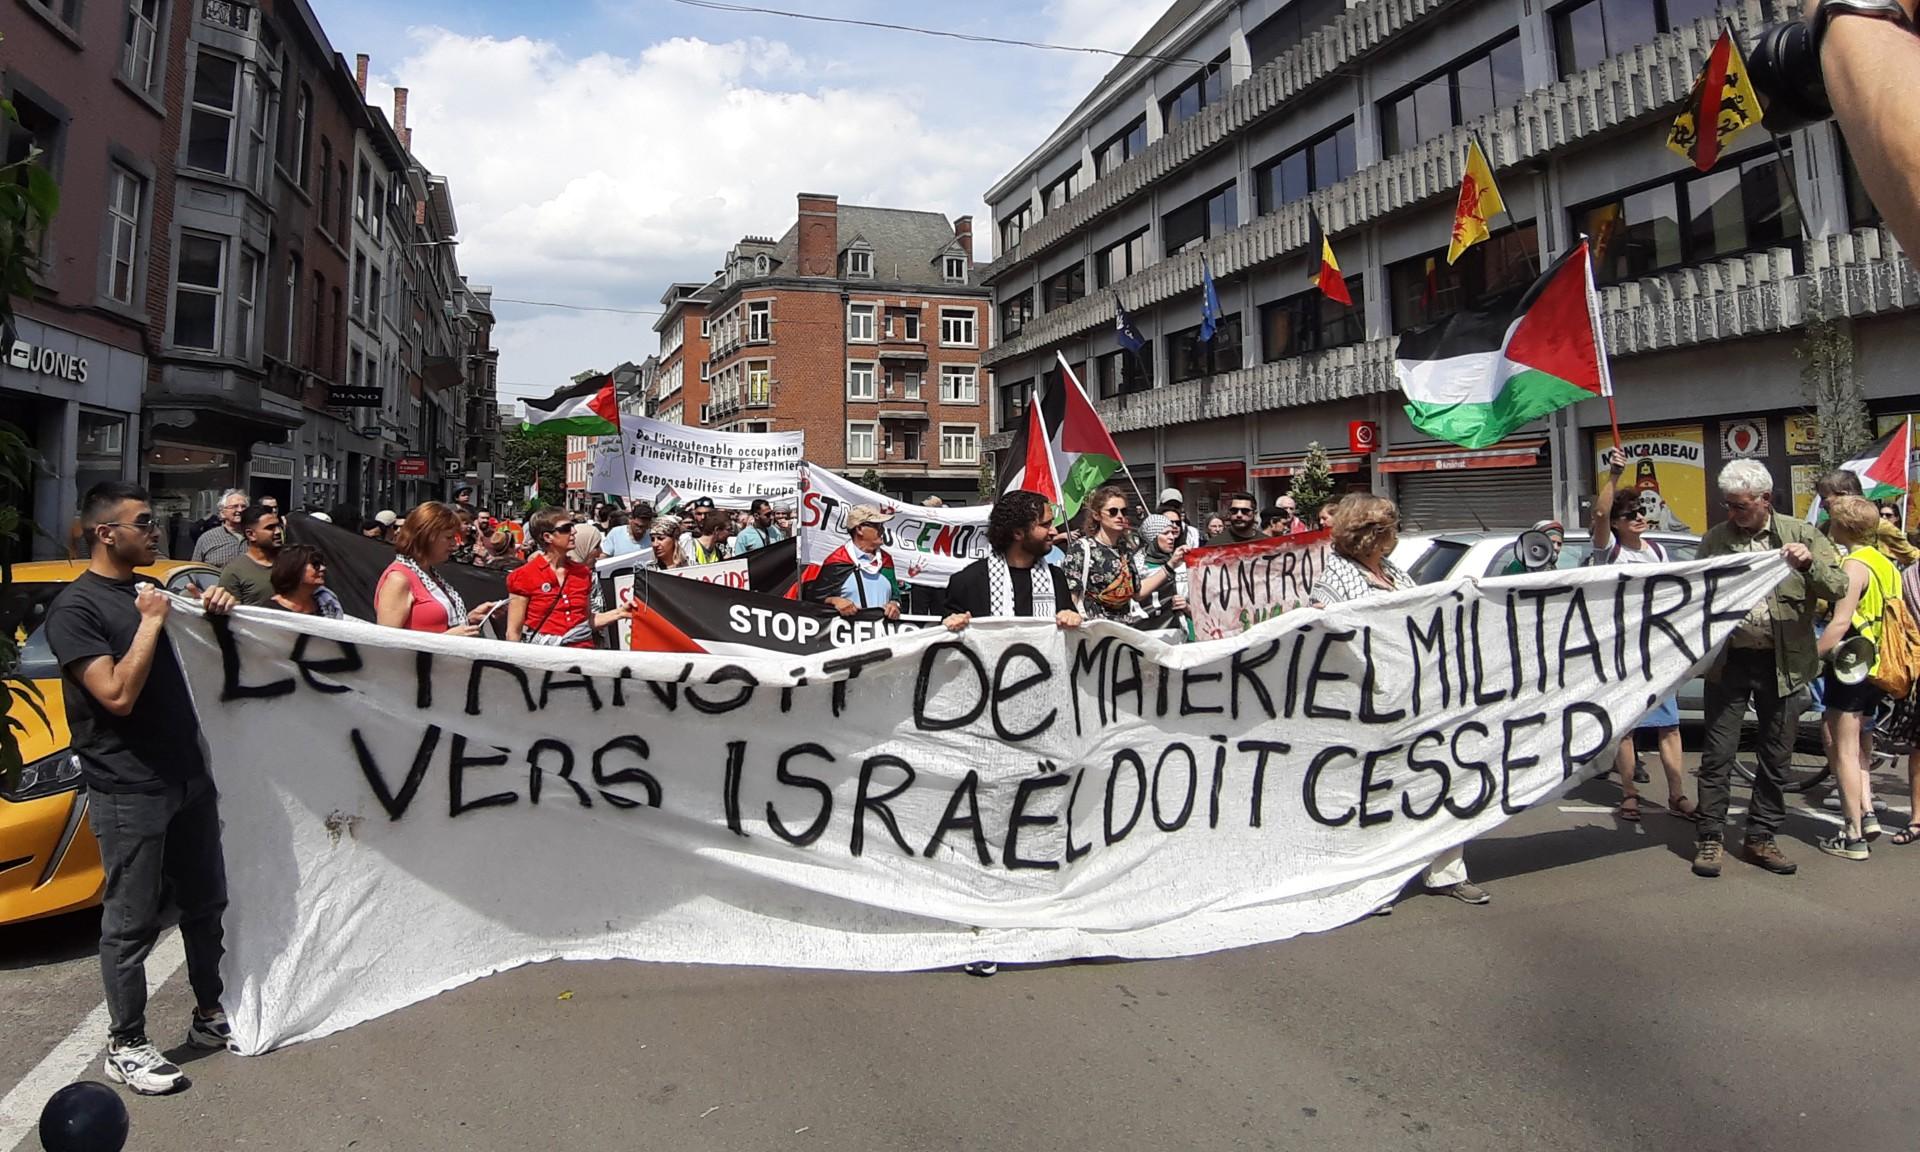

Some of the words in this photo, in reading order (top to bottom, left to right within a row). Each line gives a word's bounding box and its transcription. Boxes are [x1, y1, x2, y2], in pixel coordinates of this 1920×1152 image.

[30, 347, 89, 383] JONES
[332, 392, 379, 400] MANO
[630, 443, 636, 456] à
[640, 444, 705, 466] l'inévitable
[636, 428, 650, 441] De
[654, 432, 733, 456] l'insoutenable
[738, 444, 798, 460] occupation
[1601, 443, 1699, 466] MNCRABEAU
[450, 462, 459, 473] P
[633, 469, 724, 493] Responsabilités
[729, 481, 742, 494] de
[747, 482, 794, 498] l'Europe
[895, 518, 990, 560] GENOC
[729, 604, 820, 644] STOP
[830, 616, 922, 649] GEN
[206, 613, 363, 702] Le
[913, 640, 1058, 742] De
[351, 724, 662, 821] VERS
[723, 740, 1093, 870] ISRAËL
[1103, 734, 1291, 847] DOIT
